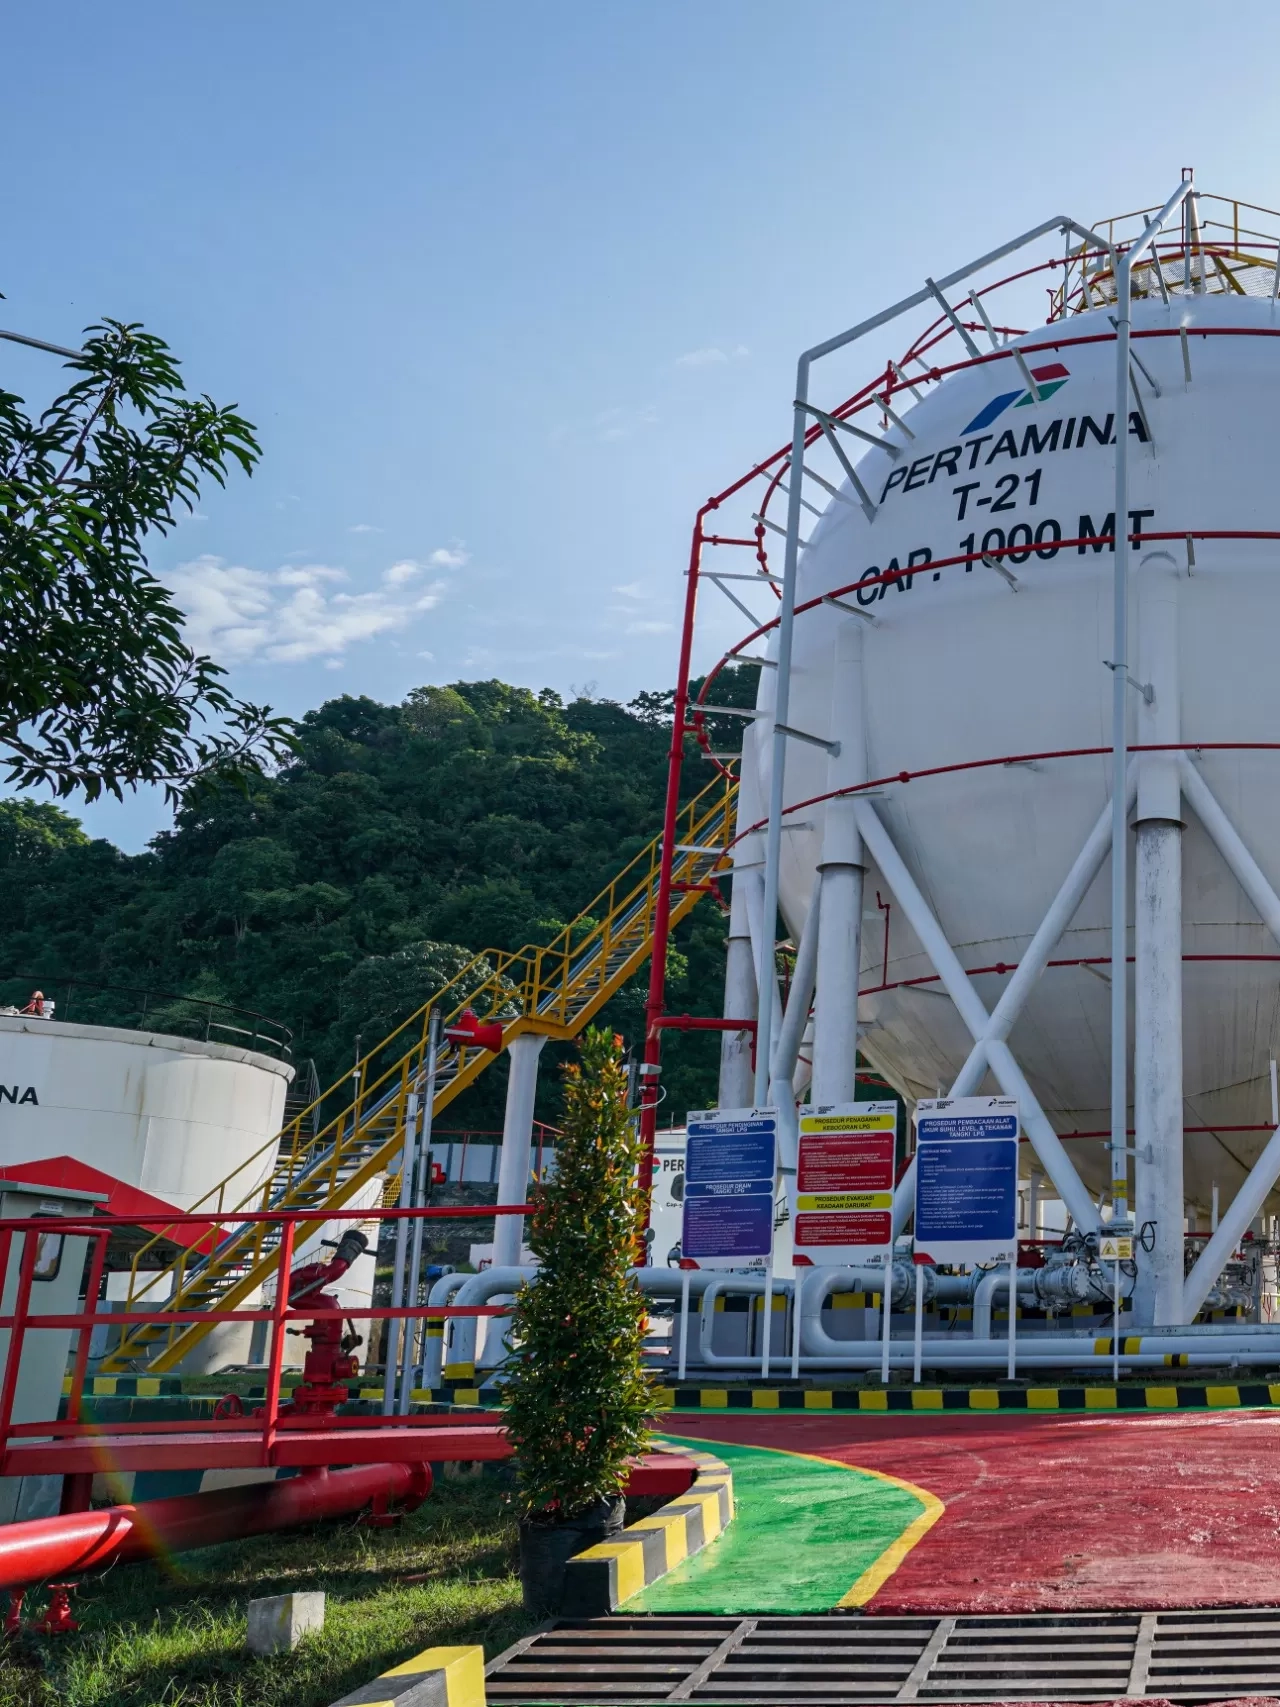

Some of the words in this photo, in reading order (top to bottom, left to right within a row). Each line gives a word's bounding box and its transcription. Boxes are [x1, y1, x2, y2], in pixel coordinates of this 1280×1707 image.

[879, 412, 1151, 504] PERTAMINA
[953, 469, 1042, 521] T-21
[857, 547, 940, 606] CAP.
[960, 519, 1061, 572] 1000
[699, 1122, 728, 1130] PROSEDUR
